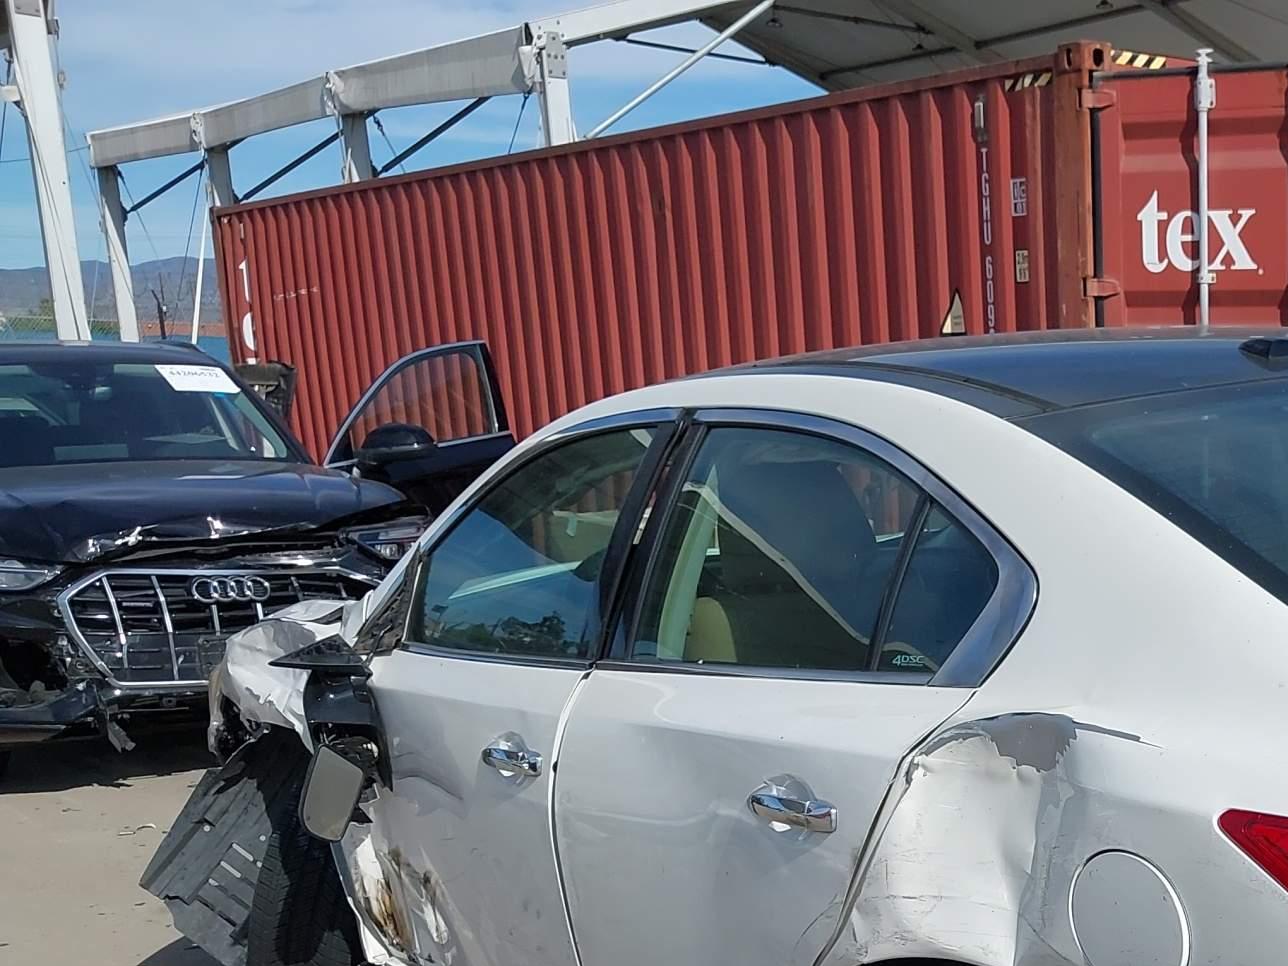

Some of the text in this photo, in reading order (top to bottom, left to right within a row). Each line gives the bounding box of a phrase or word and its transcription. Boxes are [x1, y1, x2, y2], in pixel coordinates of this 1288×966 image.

[980, 147, 992, 245] TGHU
[1137, 189, 1258, 273] tex
[891, 654, 926, 667] 4DSC
